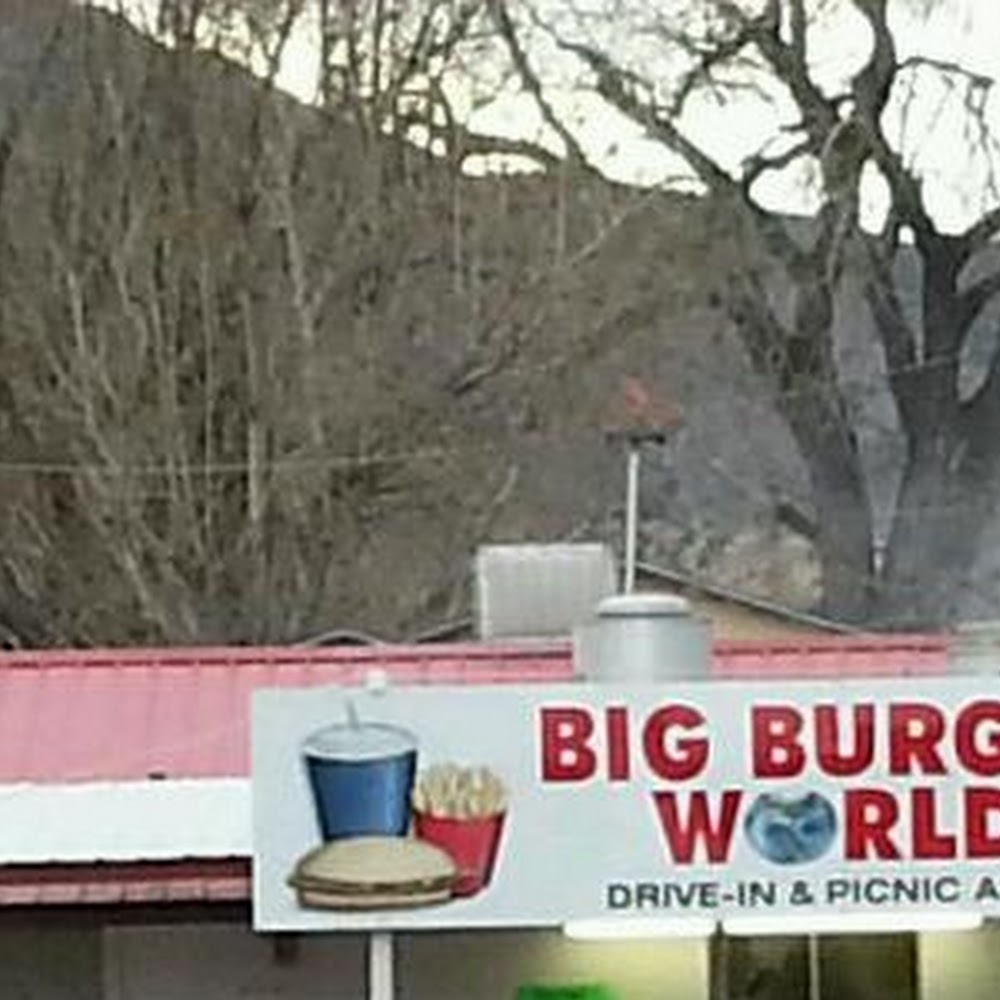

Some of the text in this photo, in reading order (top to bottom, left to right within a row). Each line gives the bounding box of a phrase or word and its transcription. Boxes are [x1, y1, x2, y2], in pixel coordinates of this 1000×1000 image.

[540, 704, 709, 783] BIG
[607, 882, 777, 909] DRIVE-IN
[789, 880, 815, 905] &
[826, 877, 960, 904] PICNIC
